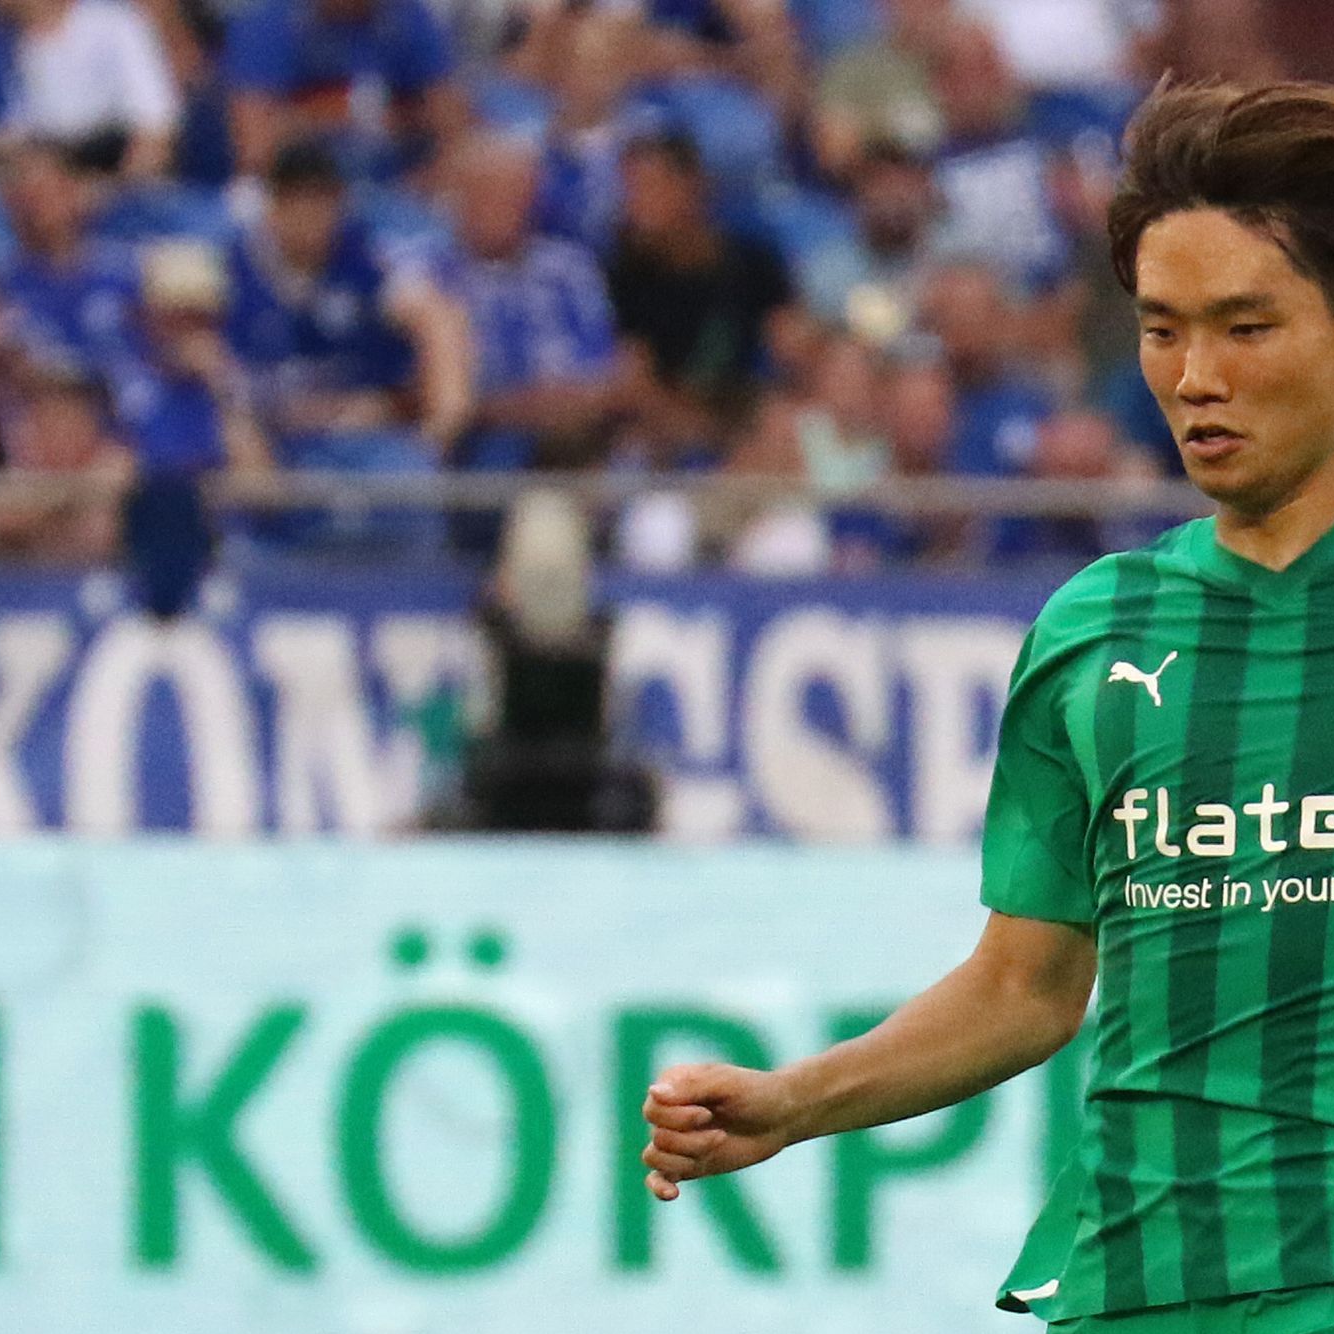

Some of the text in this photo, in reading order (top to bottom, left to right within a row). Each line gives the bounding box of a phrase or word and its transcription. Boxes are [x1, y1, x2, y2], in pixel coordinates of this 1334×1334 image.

[1124, 875, 1212, 909] Invest
[1221, 875, 1251, 907] in
[127, 930, 1087, 1275] KÖRP
